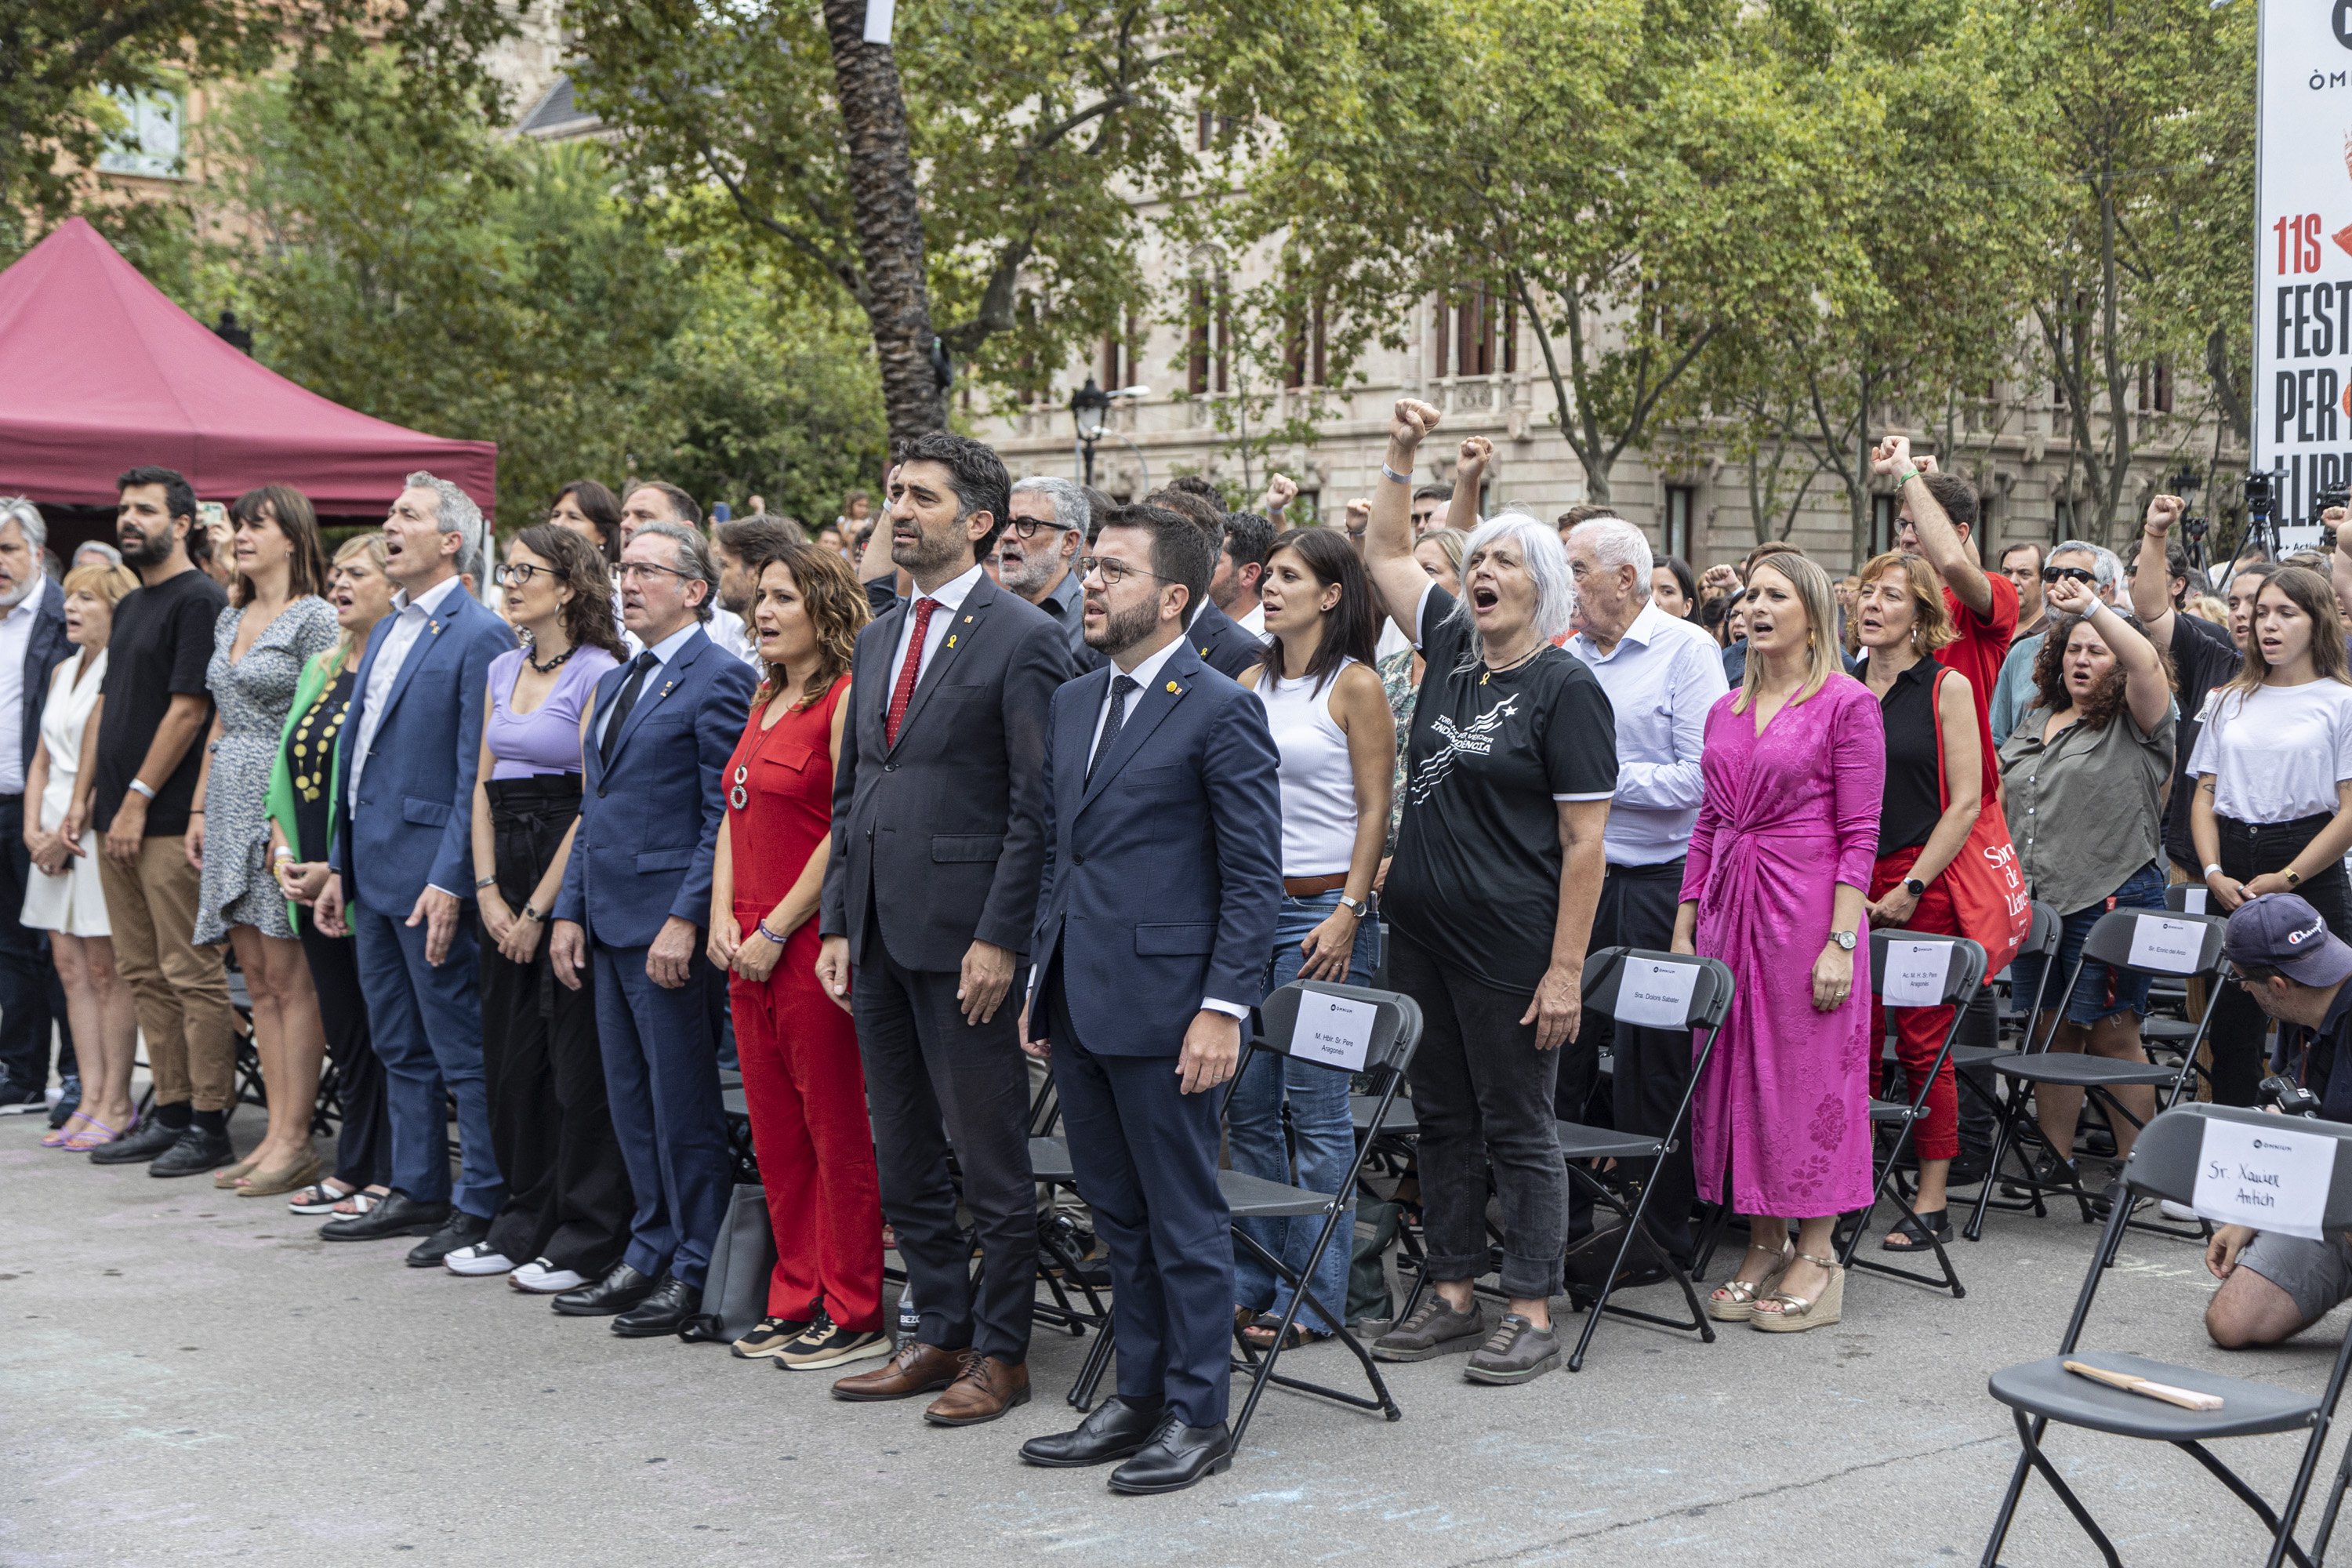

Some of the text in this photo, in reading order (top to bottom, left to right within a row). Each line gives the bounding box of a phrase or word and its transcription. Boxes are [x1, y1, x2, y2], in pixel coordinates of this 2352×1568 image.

[2309, 68, 2352, 90] ÒM
[2274, 213, 2321, 275] 11S
[2277, 281, 2352, 359] FEST
[2275, 368, 2338, 444] PER
[1646, 993, 1661, 1001] Dolors
[1342, 1038, 1354, 1047] Pere
[2208, 1160, 2280, 1188] Sr. Xavier
[2235, 1188, 2274, 1208] Antich
